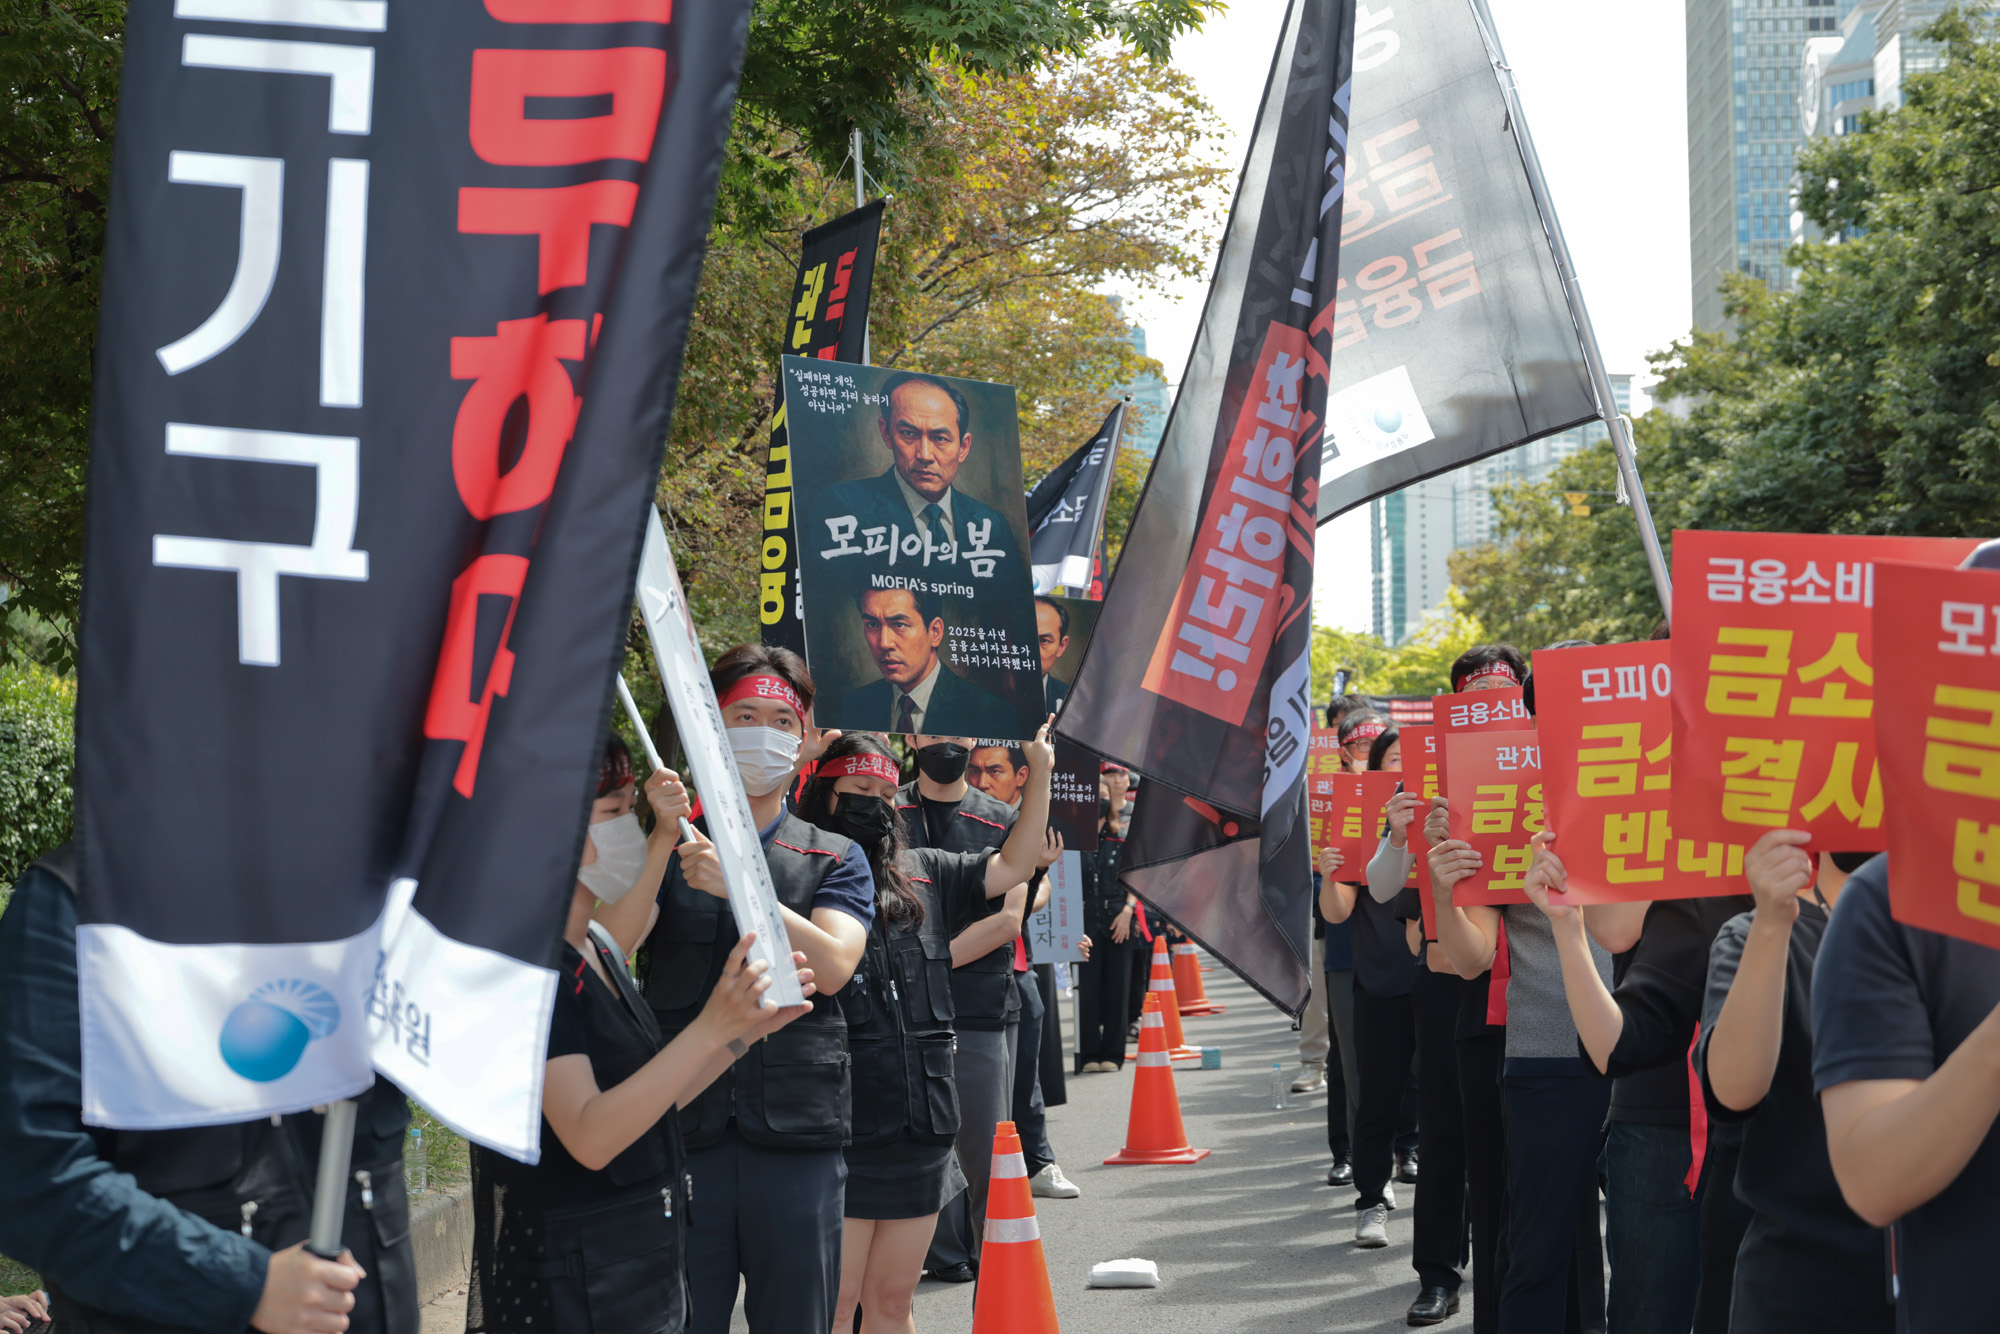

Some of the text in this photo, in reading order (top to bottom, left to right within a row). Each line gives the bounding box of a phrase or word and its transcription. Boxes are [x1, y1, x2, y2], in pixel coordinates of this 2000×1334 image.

[800, 384, 889, 407] 성공하면 자리 늘리기
[820, 514, 1006, 578] 모피아의 봄
[930, 582, 975, 599] spring
[1707, 557, 1874, 608] 금융소비
[948, 626, 1006, 642] 2025을사년
[949, 640, 1031, 657] 금융소비자보호가
[950, 655, 1037, 672] 무너지기시작했다!
[755, 678, 794, 702] 금소원
[845, 756, 884, 774] 금소원
[1496, 746, 1541, 770] 관치
[1035, 894, 1056, 948] 리자
